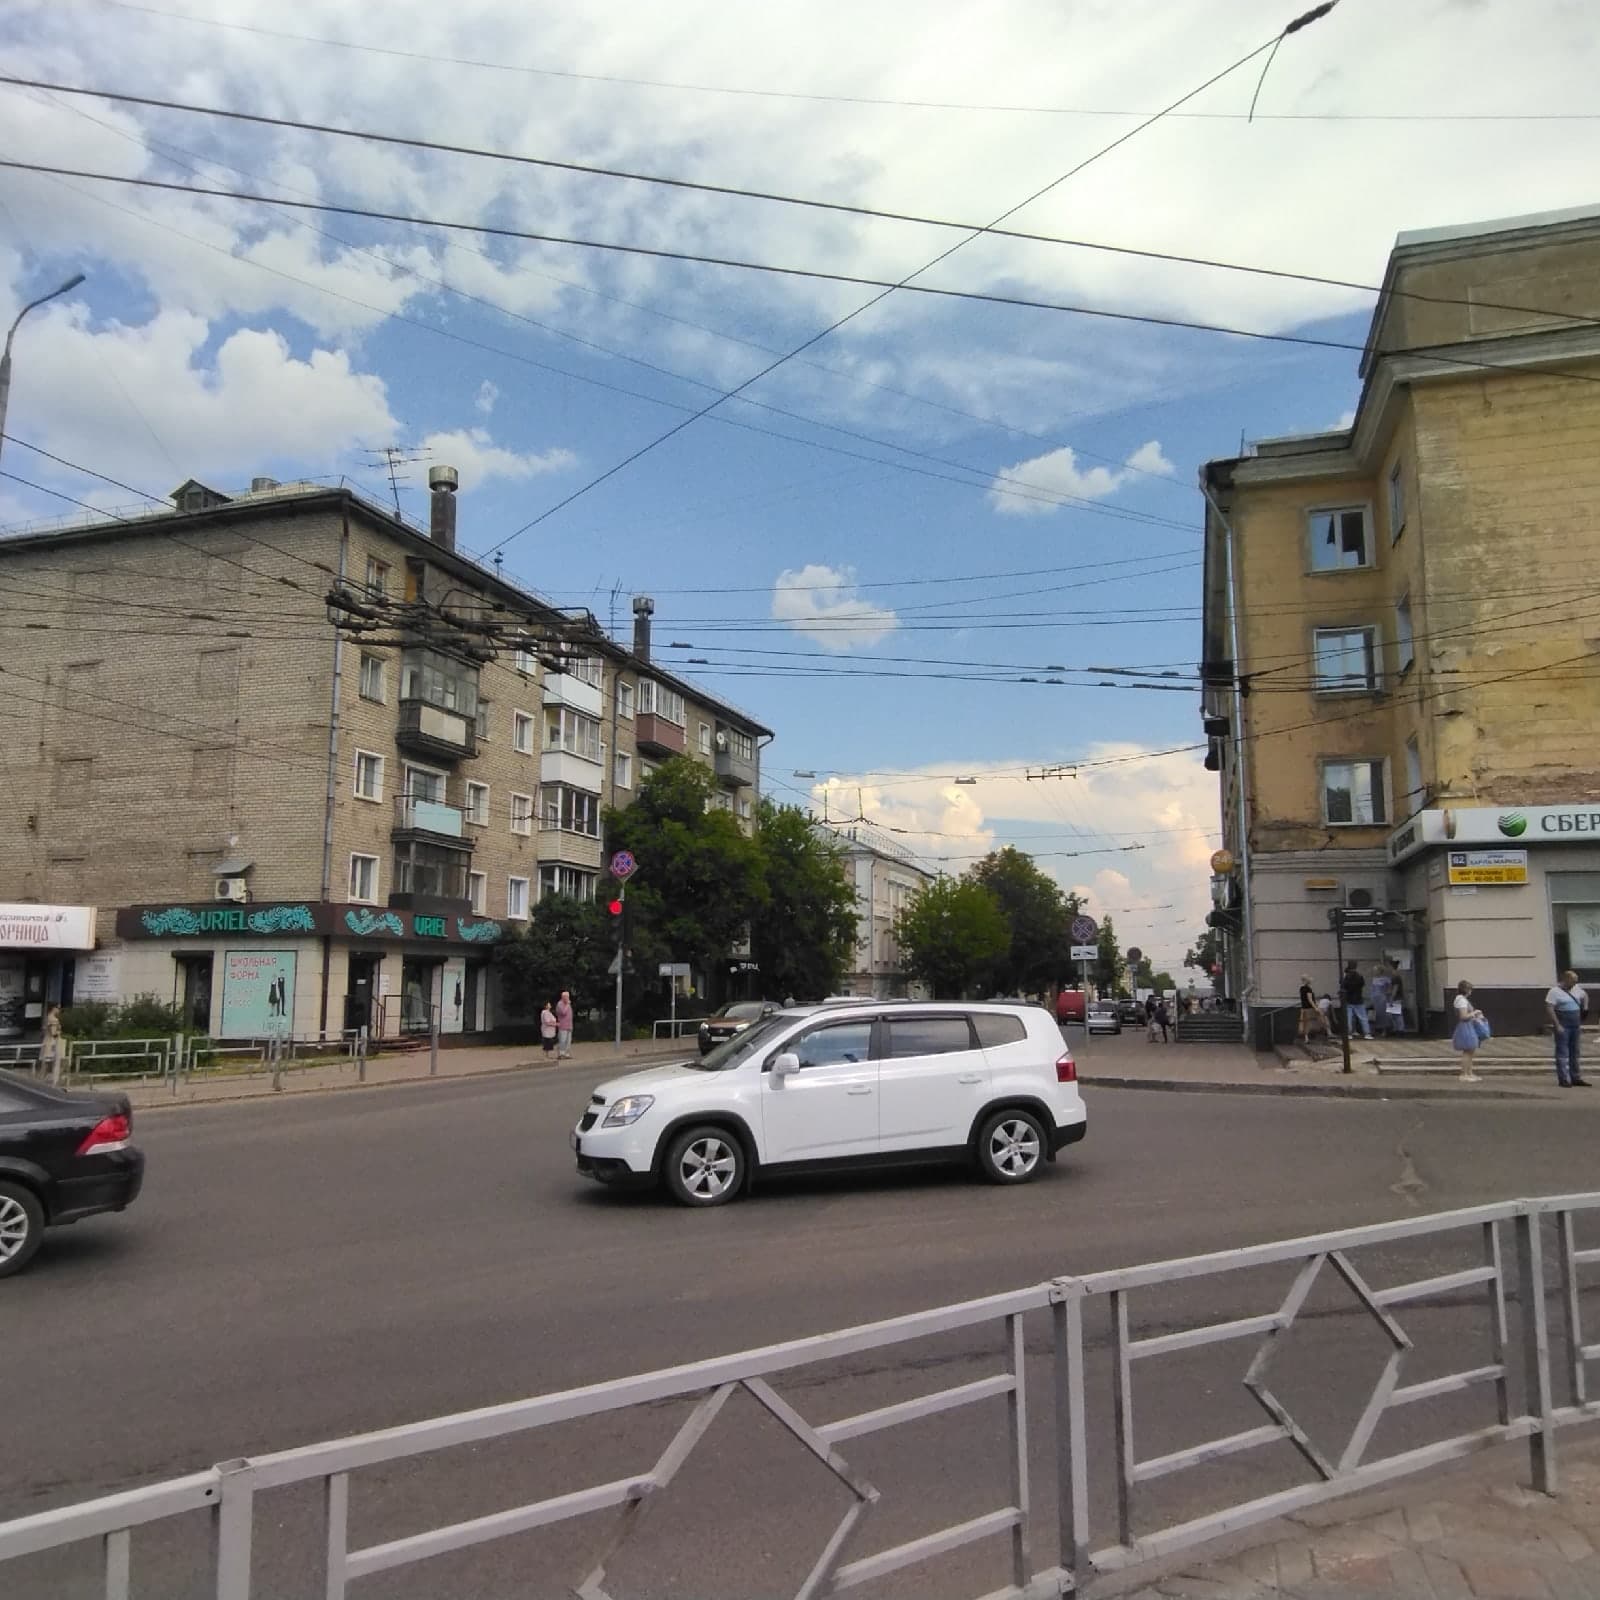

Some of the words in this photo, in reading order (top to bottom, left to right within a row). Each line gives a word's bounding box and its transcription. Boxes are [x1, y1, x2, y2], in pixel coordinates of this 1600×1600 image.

[1541, 814, 1600, 832] СБЕР
[200, 910, 249, 930] URIEL
[414, 916, 448, 937] URIEL
[230, 957, 277, 968] ШКОЛЬНАЯ
[230, 970, 260, 981] ФОРМА
